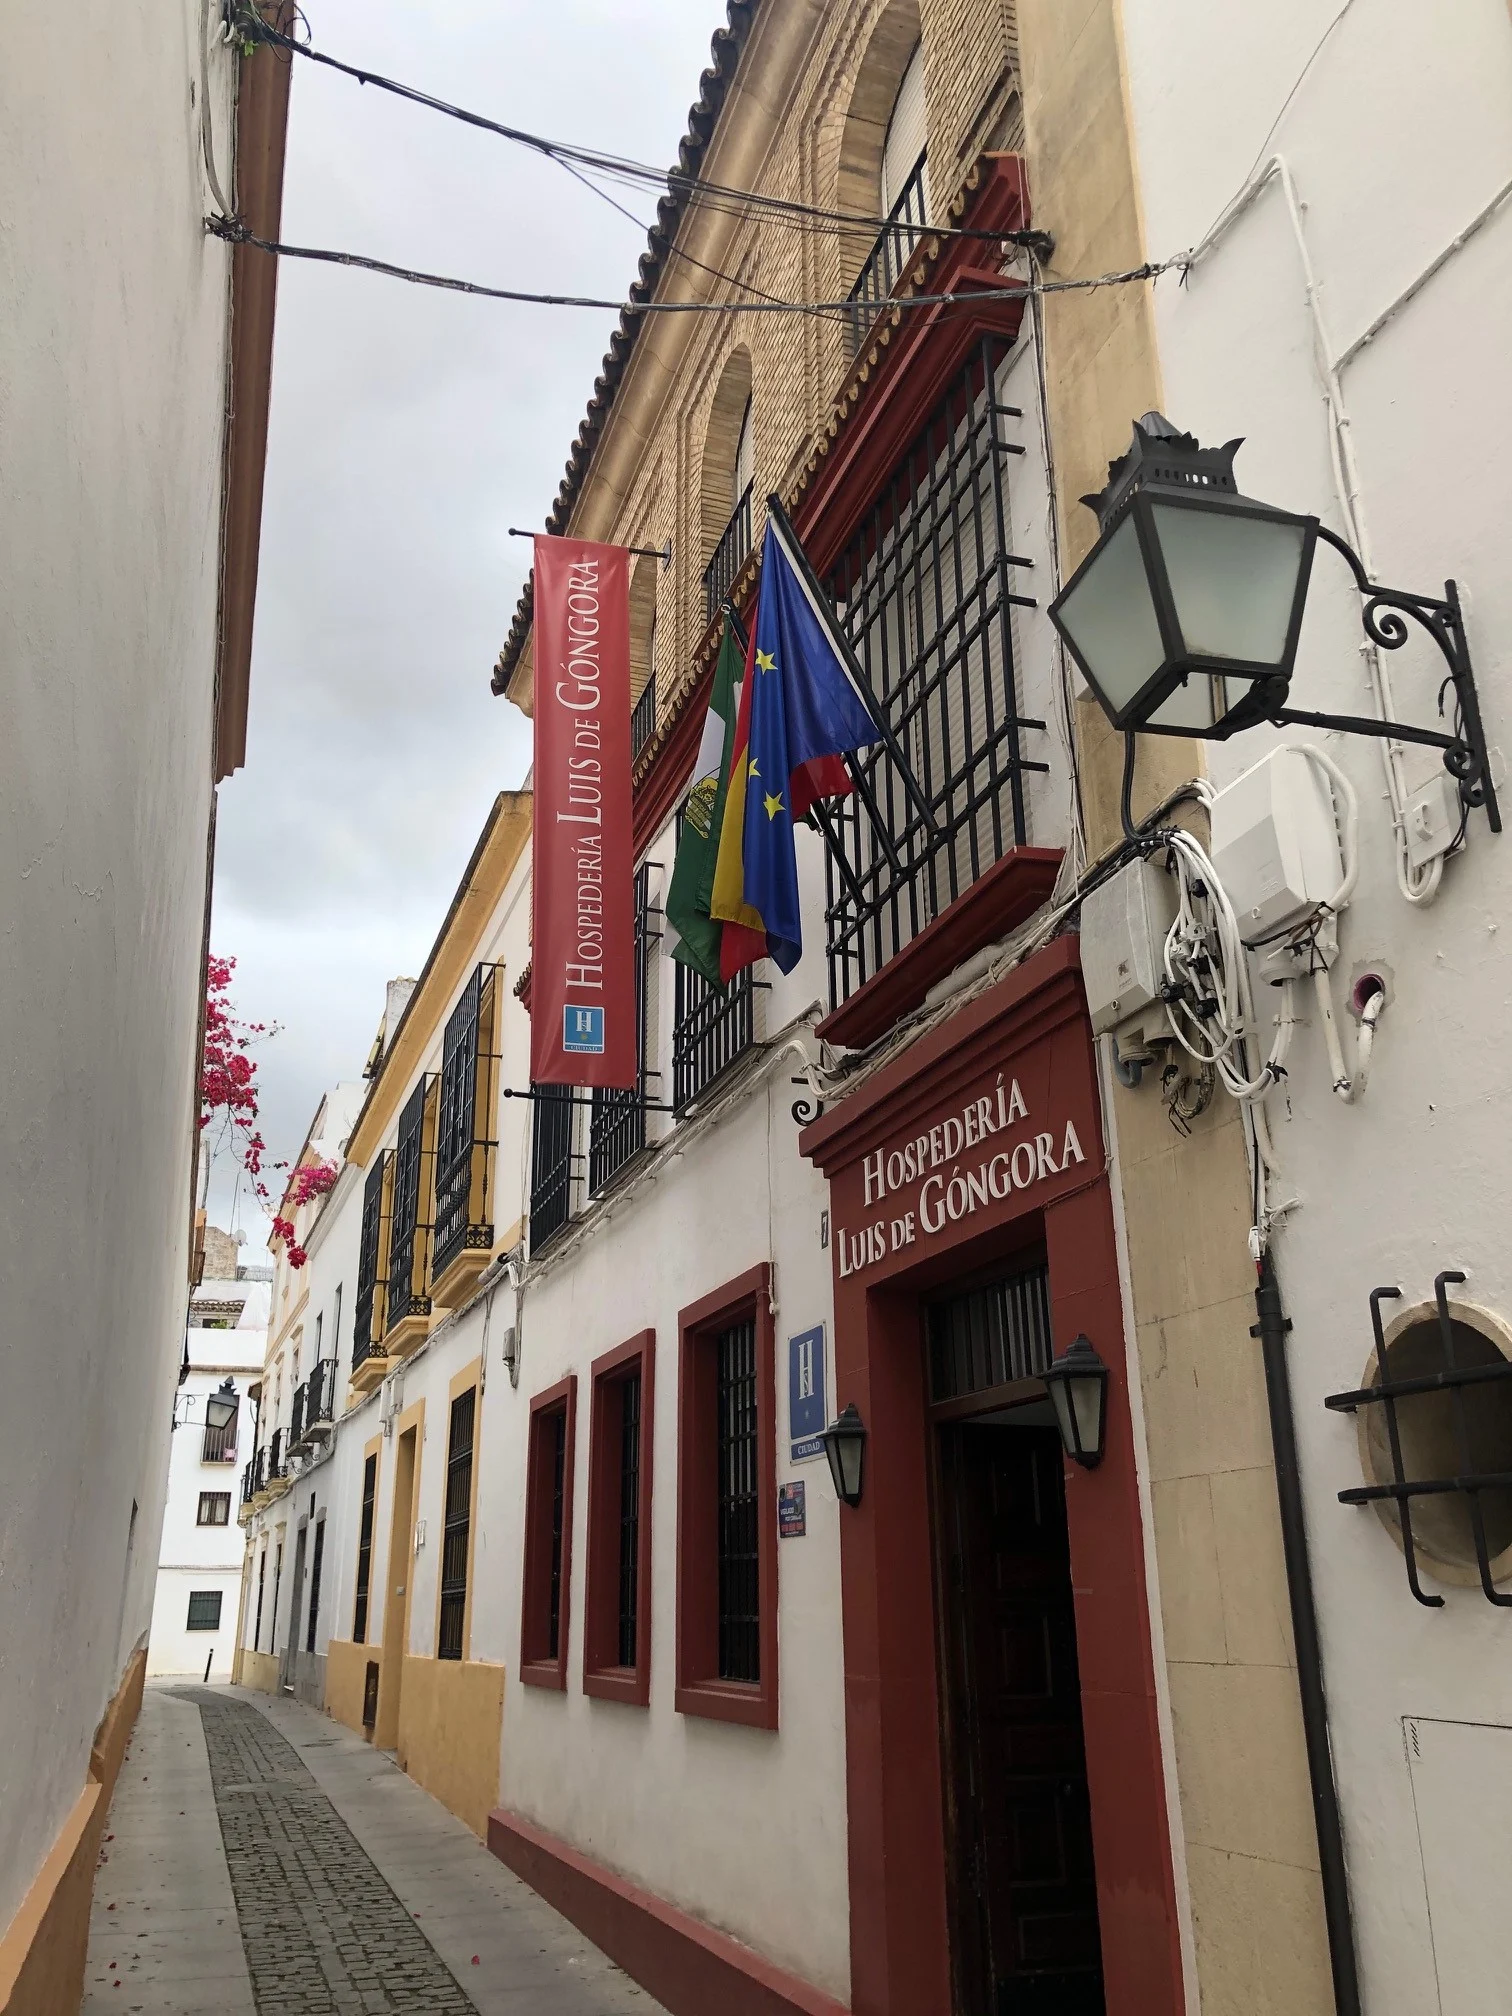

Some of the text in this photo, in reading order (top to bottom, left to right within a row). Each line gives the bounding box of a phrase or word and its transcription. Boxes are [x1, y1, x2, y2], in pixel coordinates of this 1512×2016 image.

[556, 559, 603, 990] HOSPEDERÍA LUIS DE GÓNGORA
[837, 1120, 1088, 1279] LUIS DE GÓNGORA
[862, 1073, 1030, 1208] HOSPEDERÍA
[822, 1214, 828, 1244] 7
[797, 1441, 821, 1455] CIUDAD
